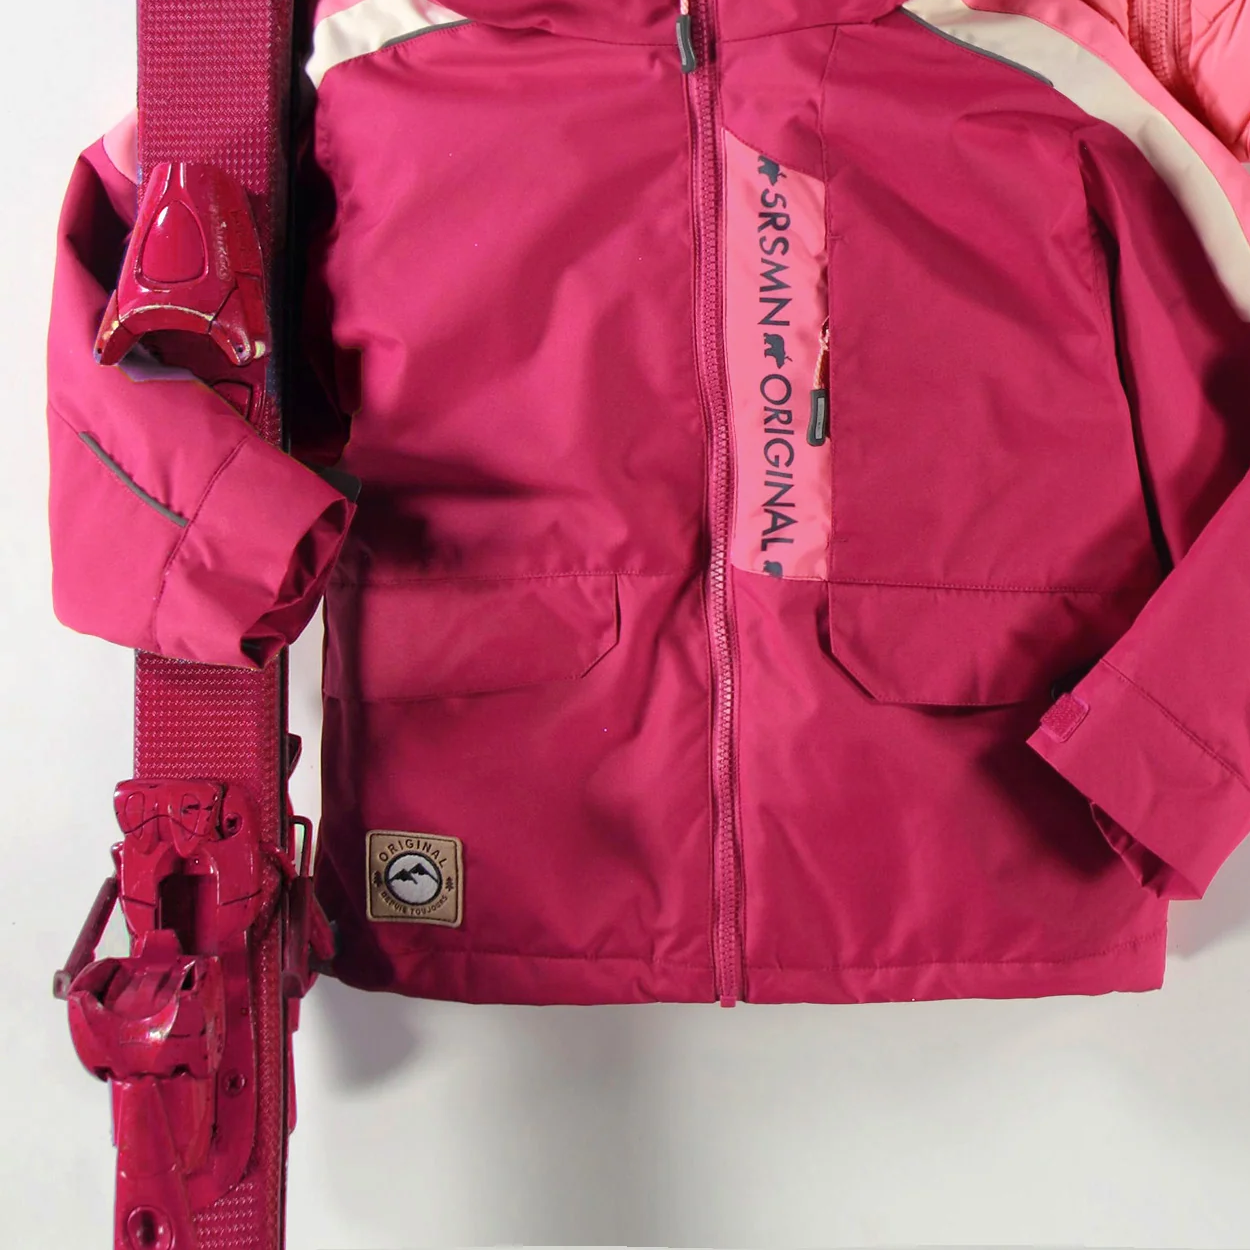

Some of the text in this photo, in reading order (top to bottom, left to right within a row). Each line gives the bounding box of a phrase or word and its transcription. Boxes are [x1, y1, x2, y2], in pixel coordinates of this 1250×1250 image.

[758, 188, 791, 326] SRSMN
[760, 374, 797, 551] ORIGINAL
[379, 839, 447, 868] ORIGINAL
